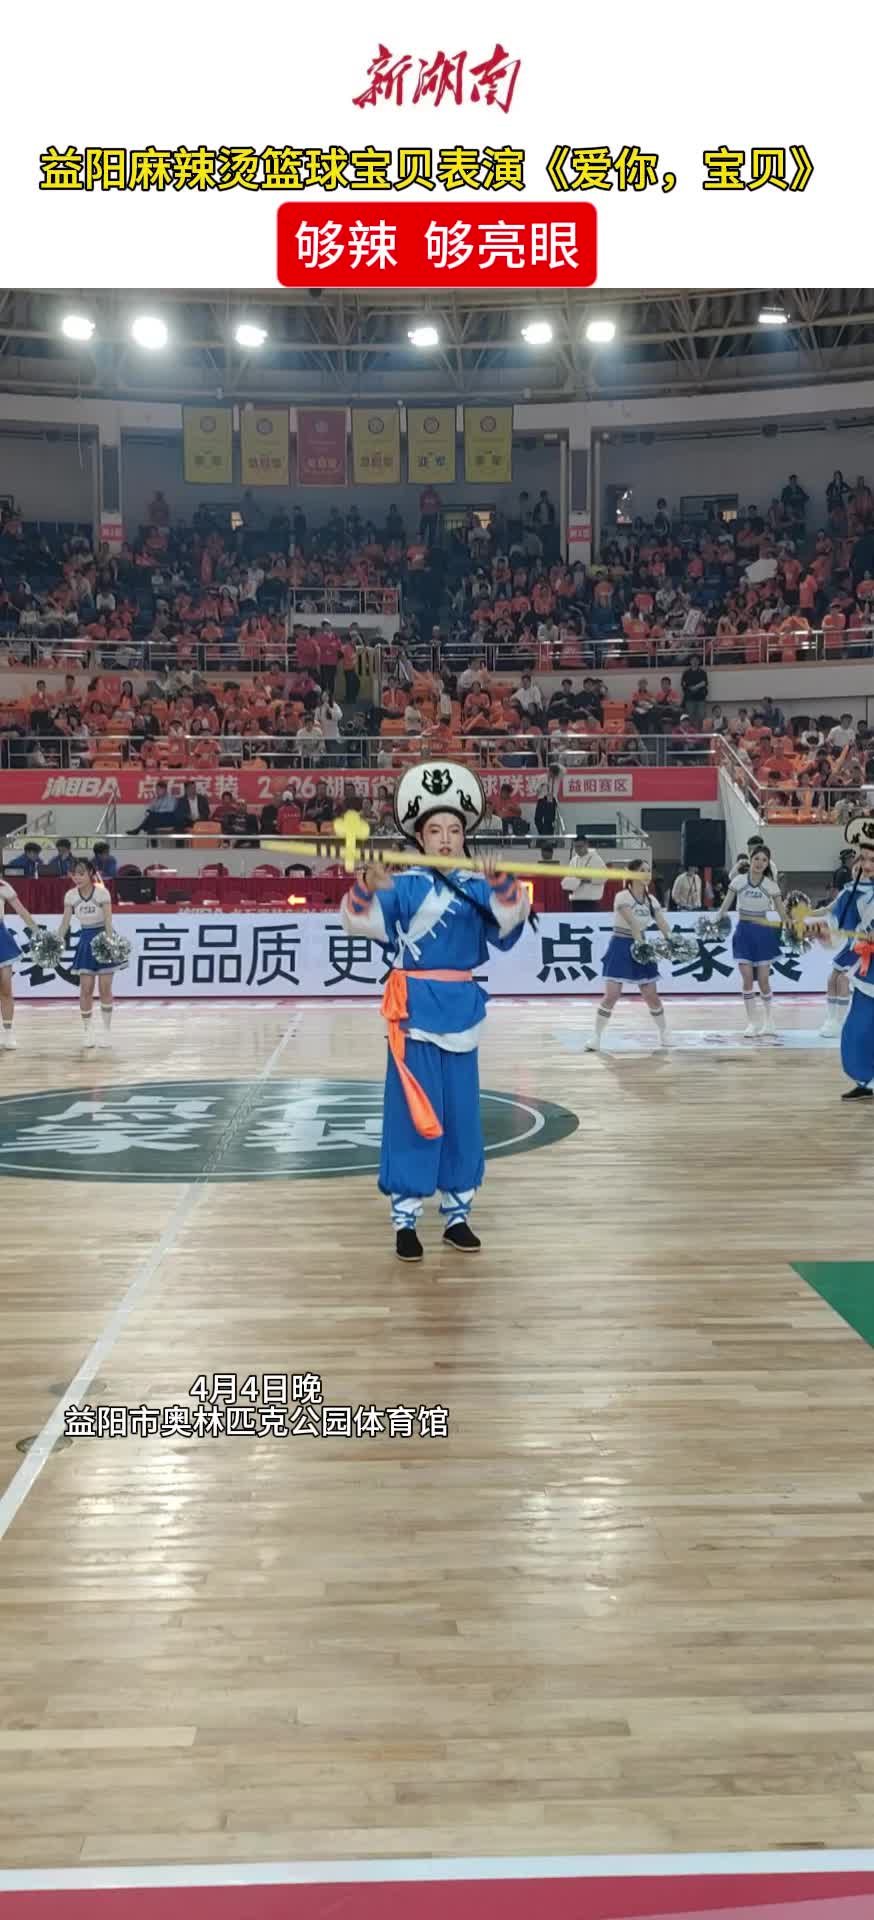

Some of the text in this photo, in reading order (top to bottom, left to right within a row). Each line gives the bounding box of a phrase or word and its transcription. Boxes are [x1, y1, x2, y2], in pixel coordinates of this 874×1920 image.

[568, 778, 627, 793] 益阳赛区
[136, 922, 301, 987] 高品质
